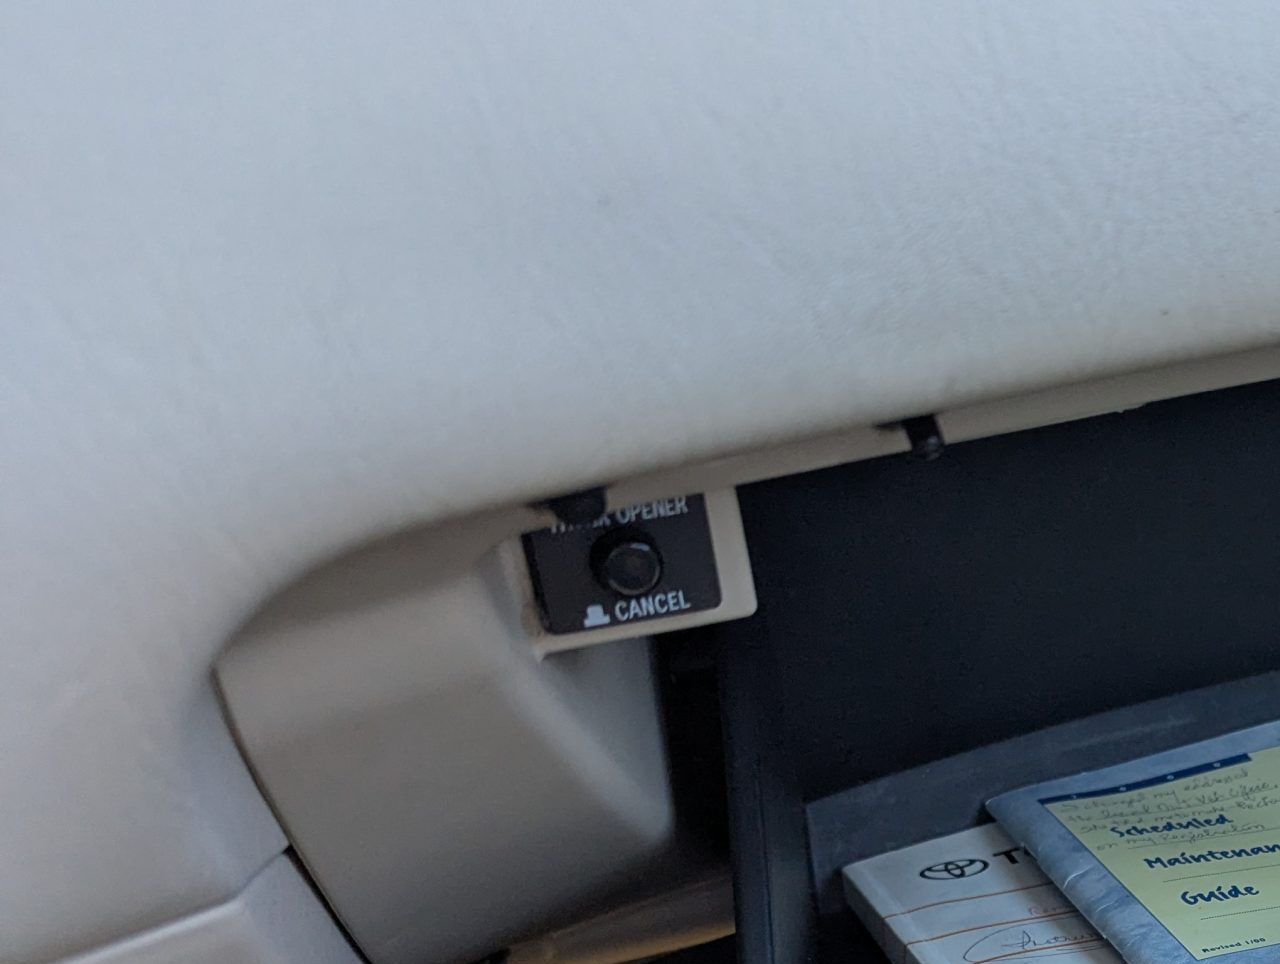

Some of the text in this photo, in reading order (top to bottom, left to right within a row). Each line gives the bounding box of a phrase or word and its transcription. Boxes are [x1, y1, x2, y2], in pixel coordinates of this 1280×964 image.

[615, 496, 688, 524] OPENER
[614, 589, 691, 621] CANCEL
[1110, 814, 1234, 838] Scheduled
[1181, 885, 1260, 905] Guide
[1201, 942, 1242, 953] Revised
